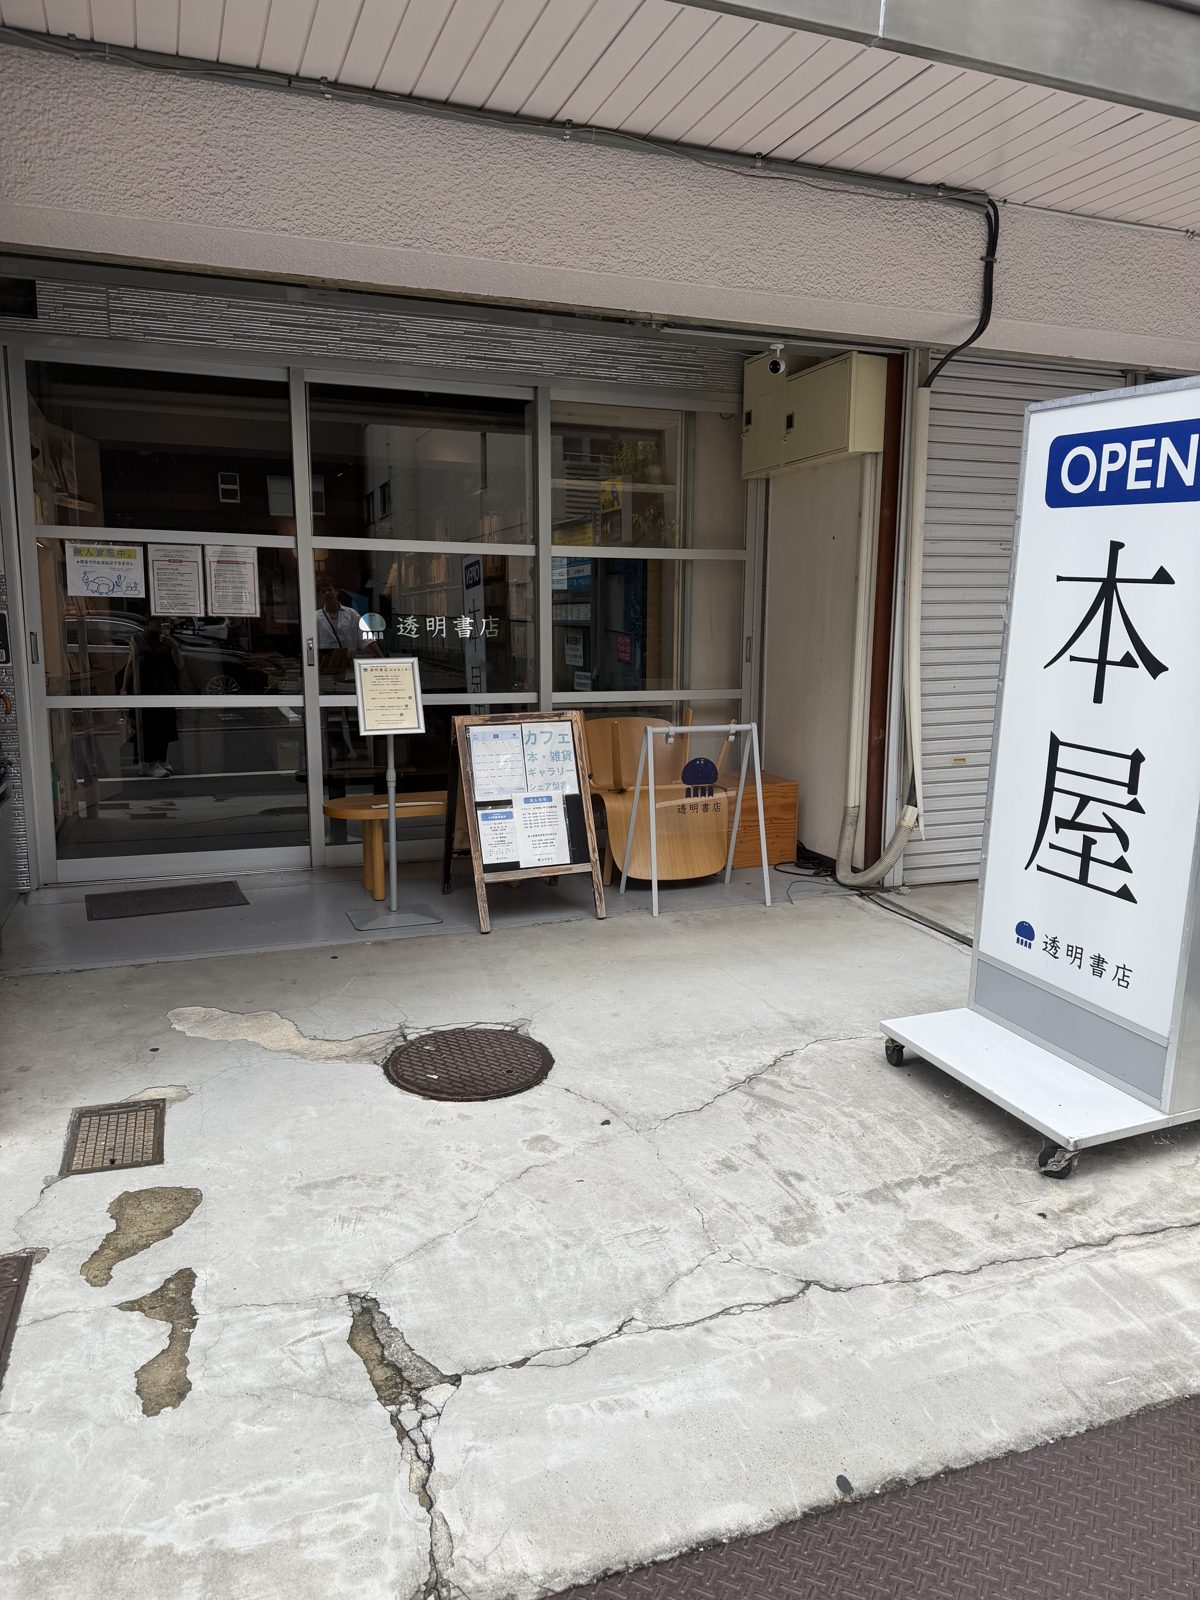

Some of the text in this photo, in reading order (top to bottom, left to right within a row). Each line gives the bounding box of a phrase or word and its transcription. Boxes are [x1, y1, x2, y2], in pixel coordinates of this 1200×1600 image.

[1060, 433, 1200, 494] OPEN
[396, 615, 500, 639] 透明書店
[1024, 540, 1176, 904] 本屋
[525, 730, 570, 745] カフェ
[527, 750, 572, 763] 本・雑貨
[528, 767, 575, 778] ギャラリー
[677, 802, 722, 814] 透明書店
[1042, 932, 1134, 990] 透明書店
